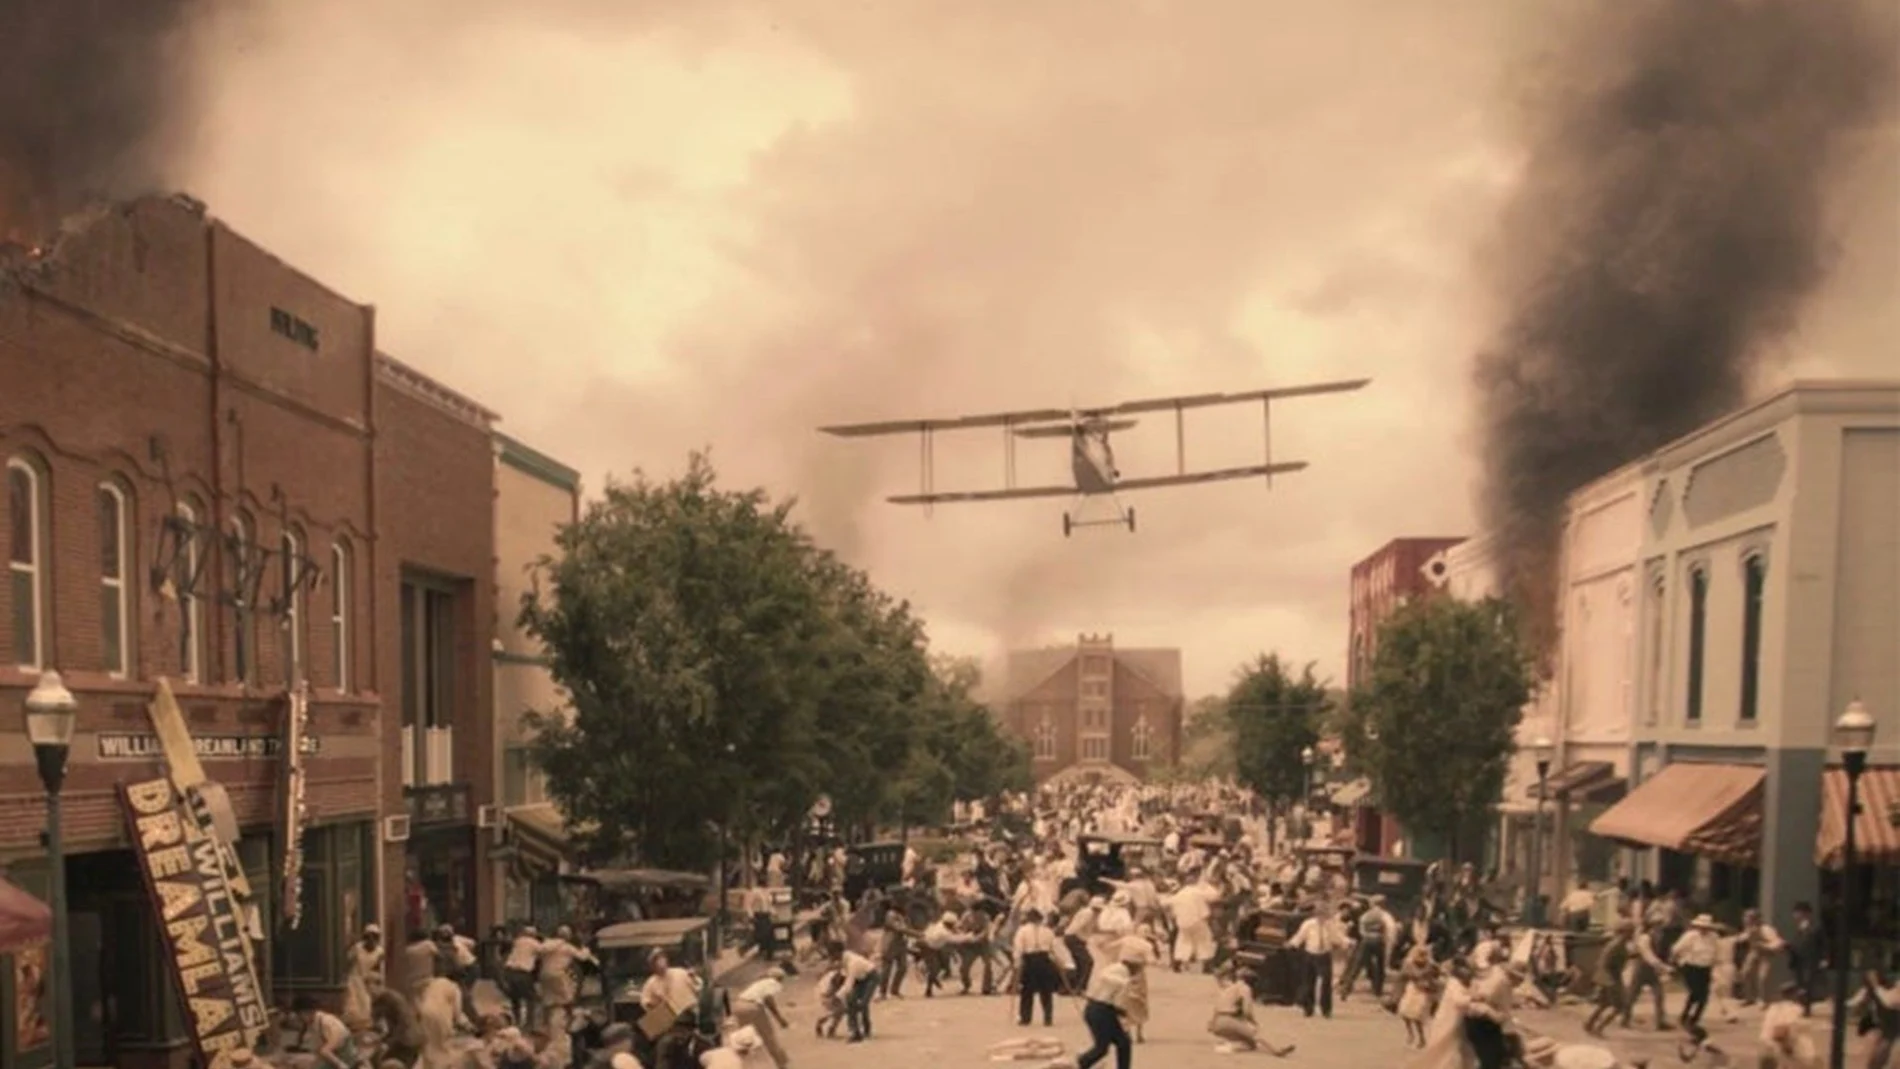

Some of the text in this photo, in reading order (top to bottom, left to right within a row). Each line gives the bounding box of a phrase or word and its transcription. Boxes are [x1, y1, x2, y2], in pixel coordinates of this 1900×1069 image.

[101, 736, 168, 756] WILLIA
[193, 736, 265, 755] REAMLAND
[194, 841, 263, 1027] WILLIAMS
